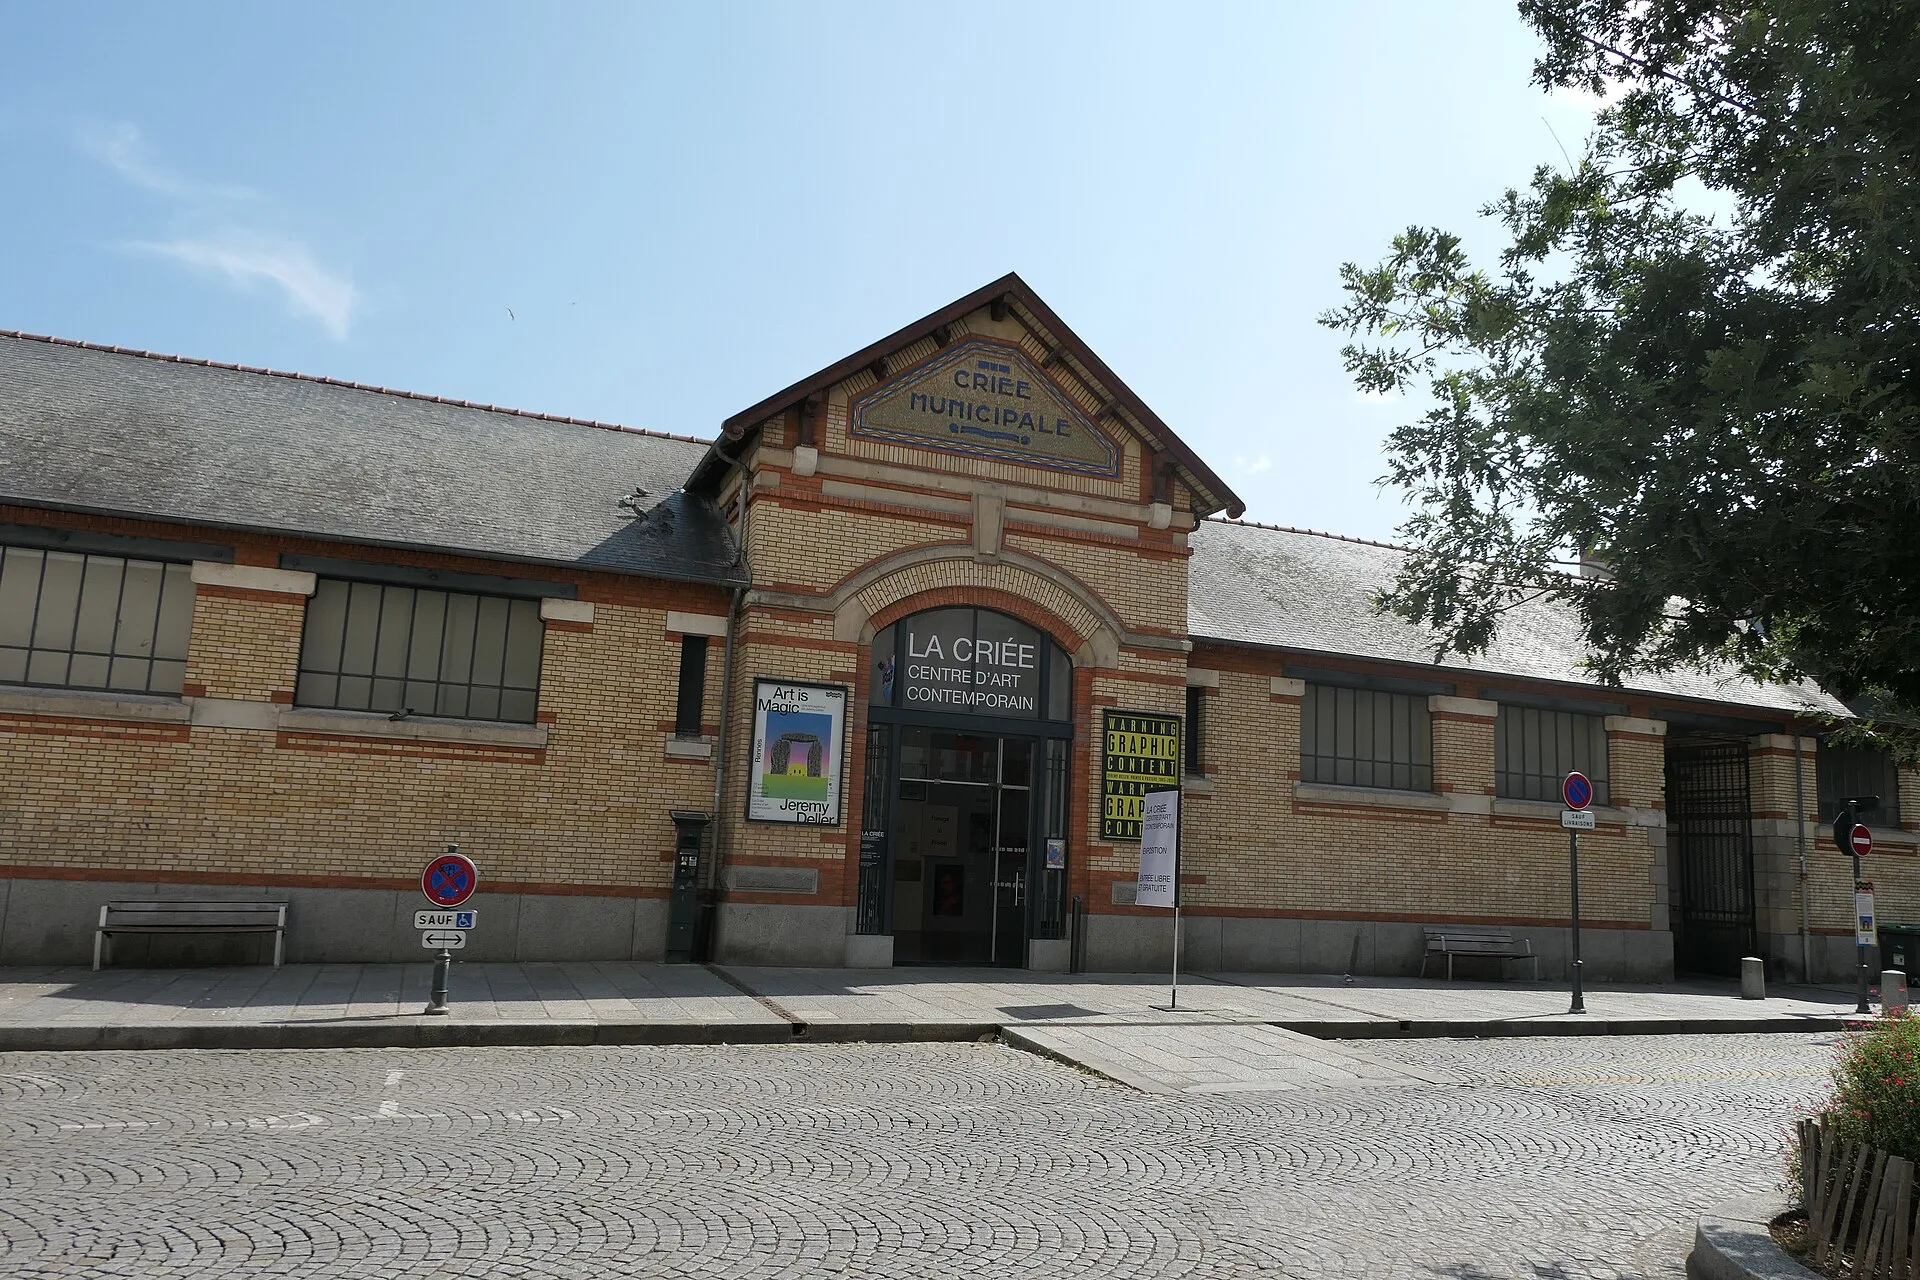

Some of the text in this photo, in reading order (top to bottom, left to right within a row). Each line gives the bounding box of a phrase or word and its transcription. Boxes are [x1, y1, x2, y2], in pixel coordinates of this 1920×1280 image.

[910, 392, 1072, 437] MUNICIPALE
[909, 632, 1035, 669] LA CRIÉE
[908, 664, 971, 684] CENTRE
[773, 687, 808, 702] Art is
[907, 686, 1033, 711] CONTEMPORAIN
[758, 698, 800, 716] Magic
[1109, 717, 1176, 736] WARNING
[1108, 733, 1175, 757] GRAPHIC
[1107, 756, 1175, 775] CONTENT
[1106, 781, 1145, 796] WARN
[780, 798, 829, 816] Jeremy
[1106, 797, 1145, 818] GRAP
[1147, 806, 1152, 814] LA
[797, 812, 834, 824] Deller
[1105, 820, 1142, 837] CONT
[1154, 874, 1170, 882] LIBRE
[1142, 884, 1166, 892] GRATUITE
[419, 915, 453, 925] SAUF
